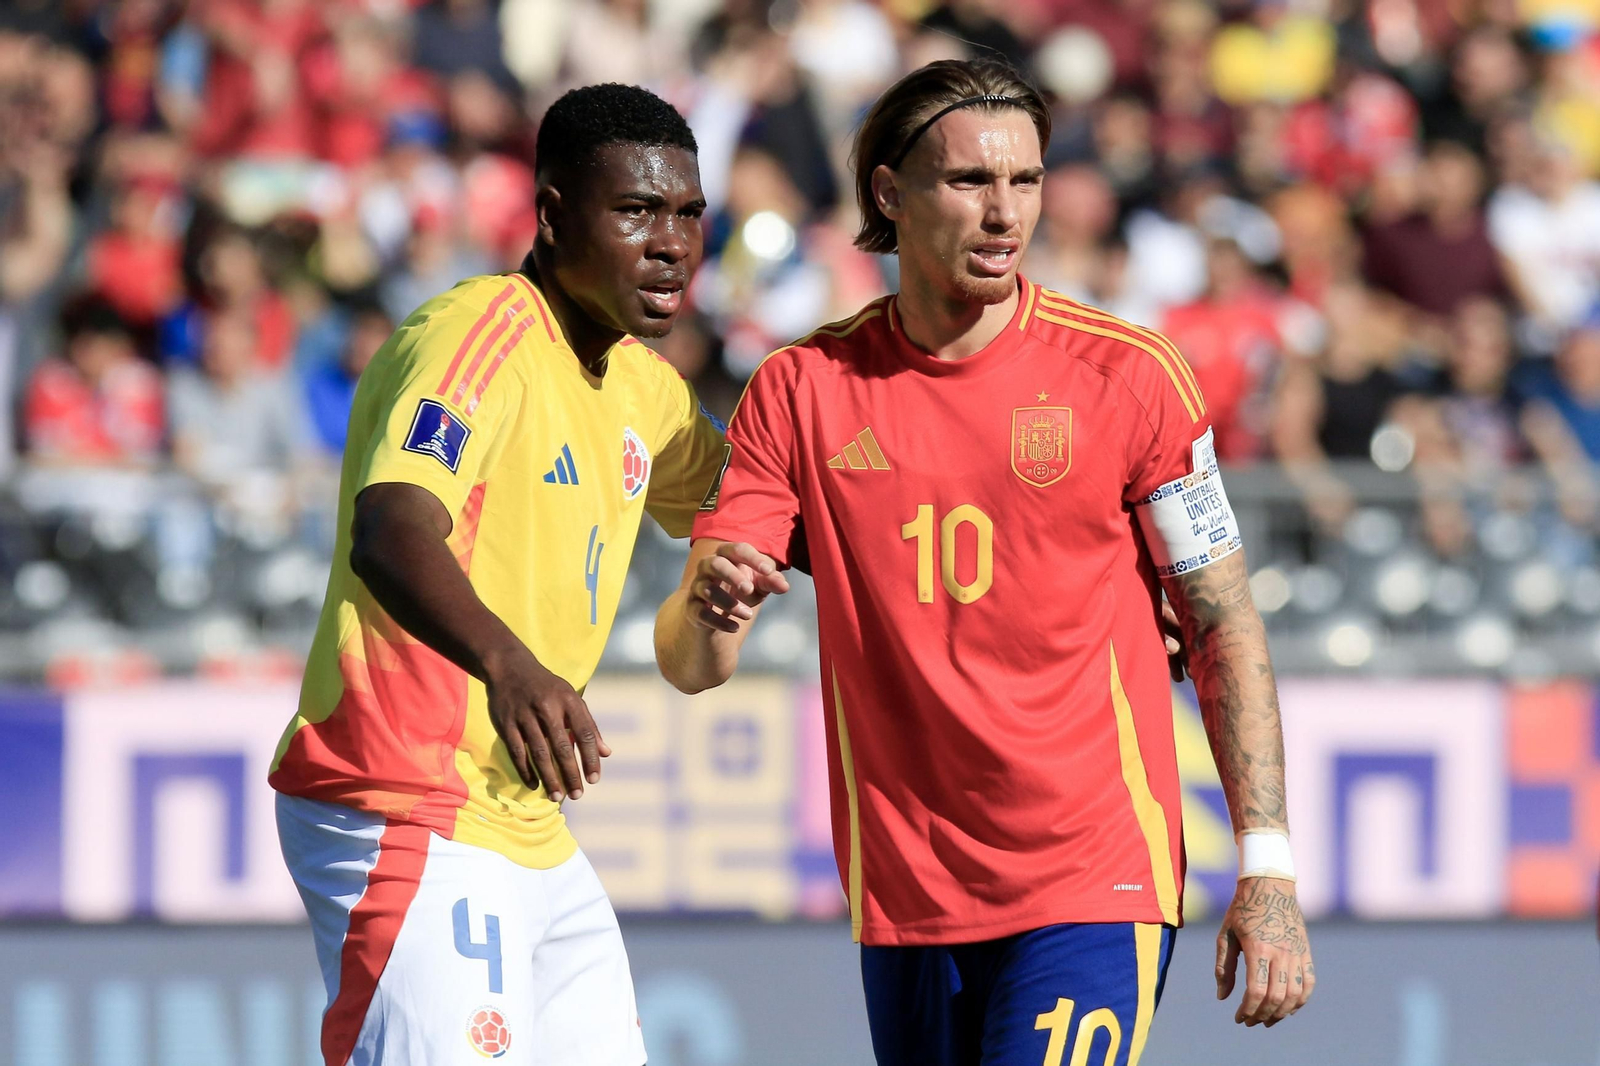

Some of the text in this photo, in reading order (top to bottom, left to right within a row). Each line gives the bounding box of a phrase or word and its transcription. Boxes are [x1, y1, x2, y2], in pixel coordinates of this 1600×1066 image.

[1181, 480, 1216, 505] FOOTBALL
[1186, 491, 1222, 520] UNITES
[1190, 507, 1229, 536] the World
[1210, 528, 1227, 542] FIFA
[585, 524, 604, 625] 4
[901, 503, 993, 605] 10
[452, 898, 503, 994] 4
[1034, 997, 1121, 1066] 10
